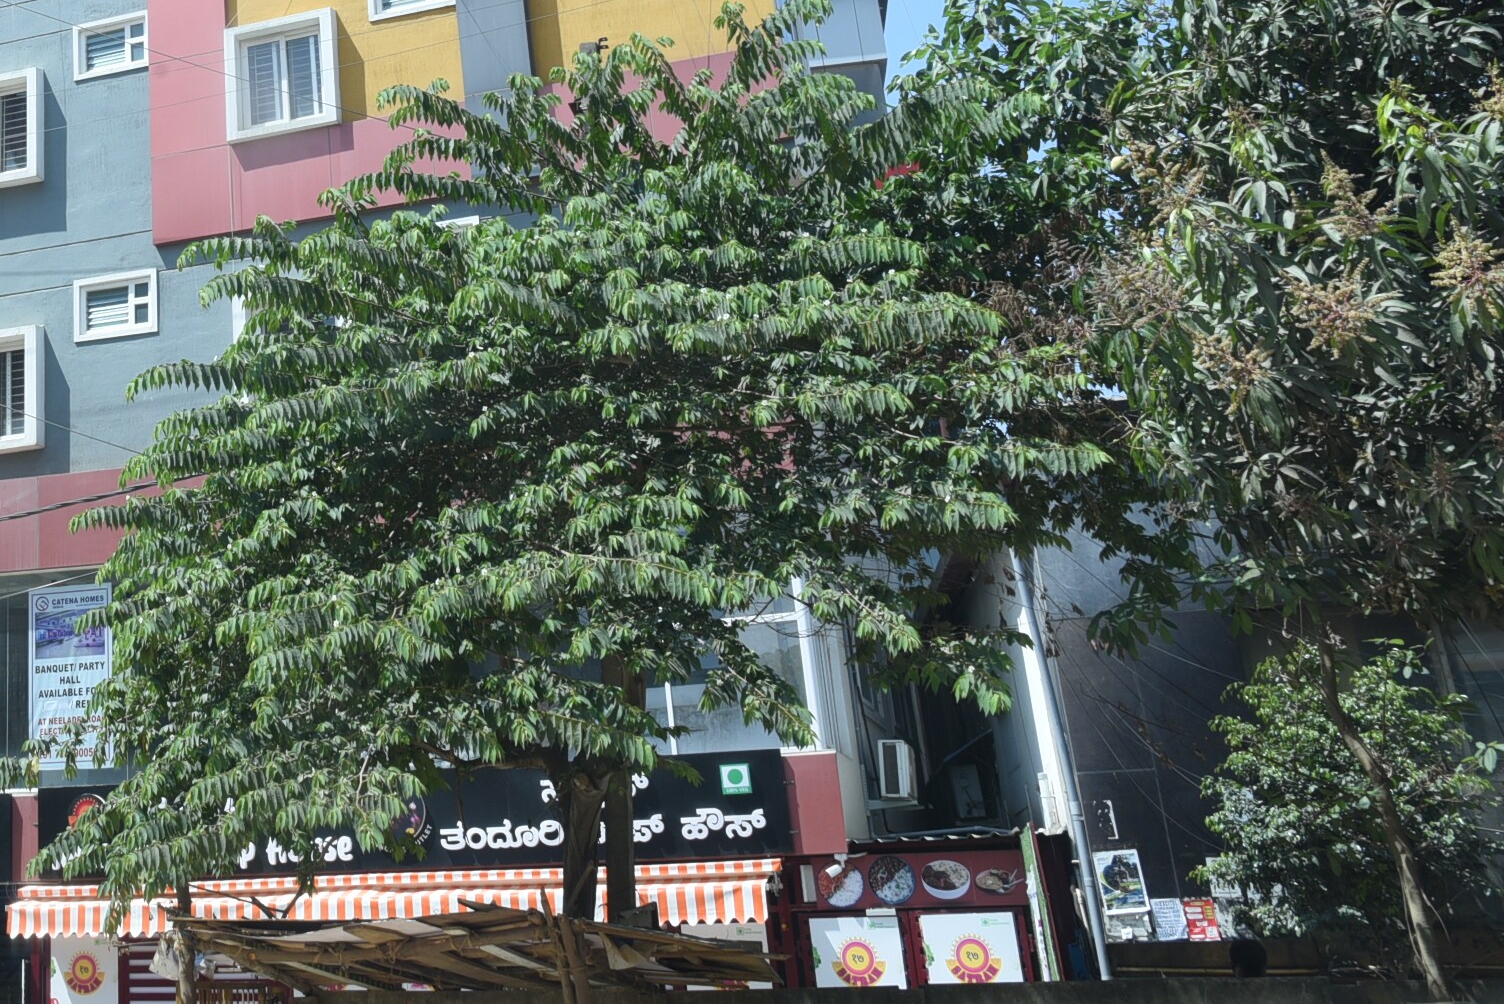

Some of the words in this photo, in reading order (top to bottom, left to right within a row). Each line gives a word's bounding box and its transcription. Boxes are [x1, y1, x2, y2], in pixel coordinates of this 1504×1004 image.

[52, 597, 78, 605] CATENA
[80, 595, 104, 603] HOMES
[79, 661, 105, 672] PARTY
[60, 675, 81, 685] HALL
[39, 687, 83, 698] AVAILABLE
[86, 687, 96, 695] FO
[76, 699, 89, 709] RE
[38, 718, 46, 726] AT
[49, 716, 83, 725] NEELADR
